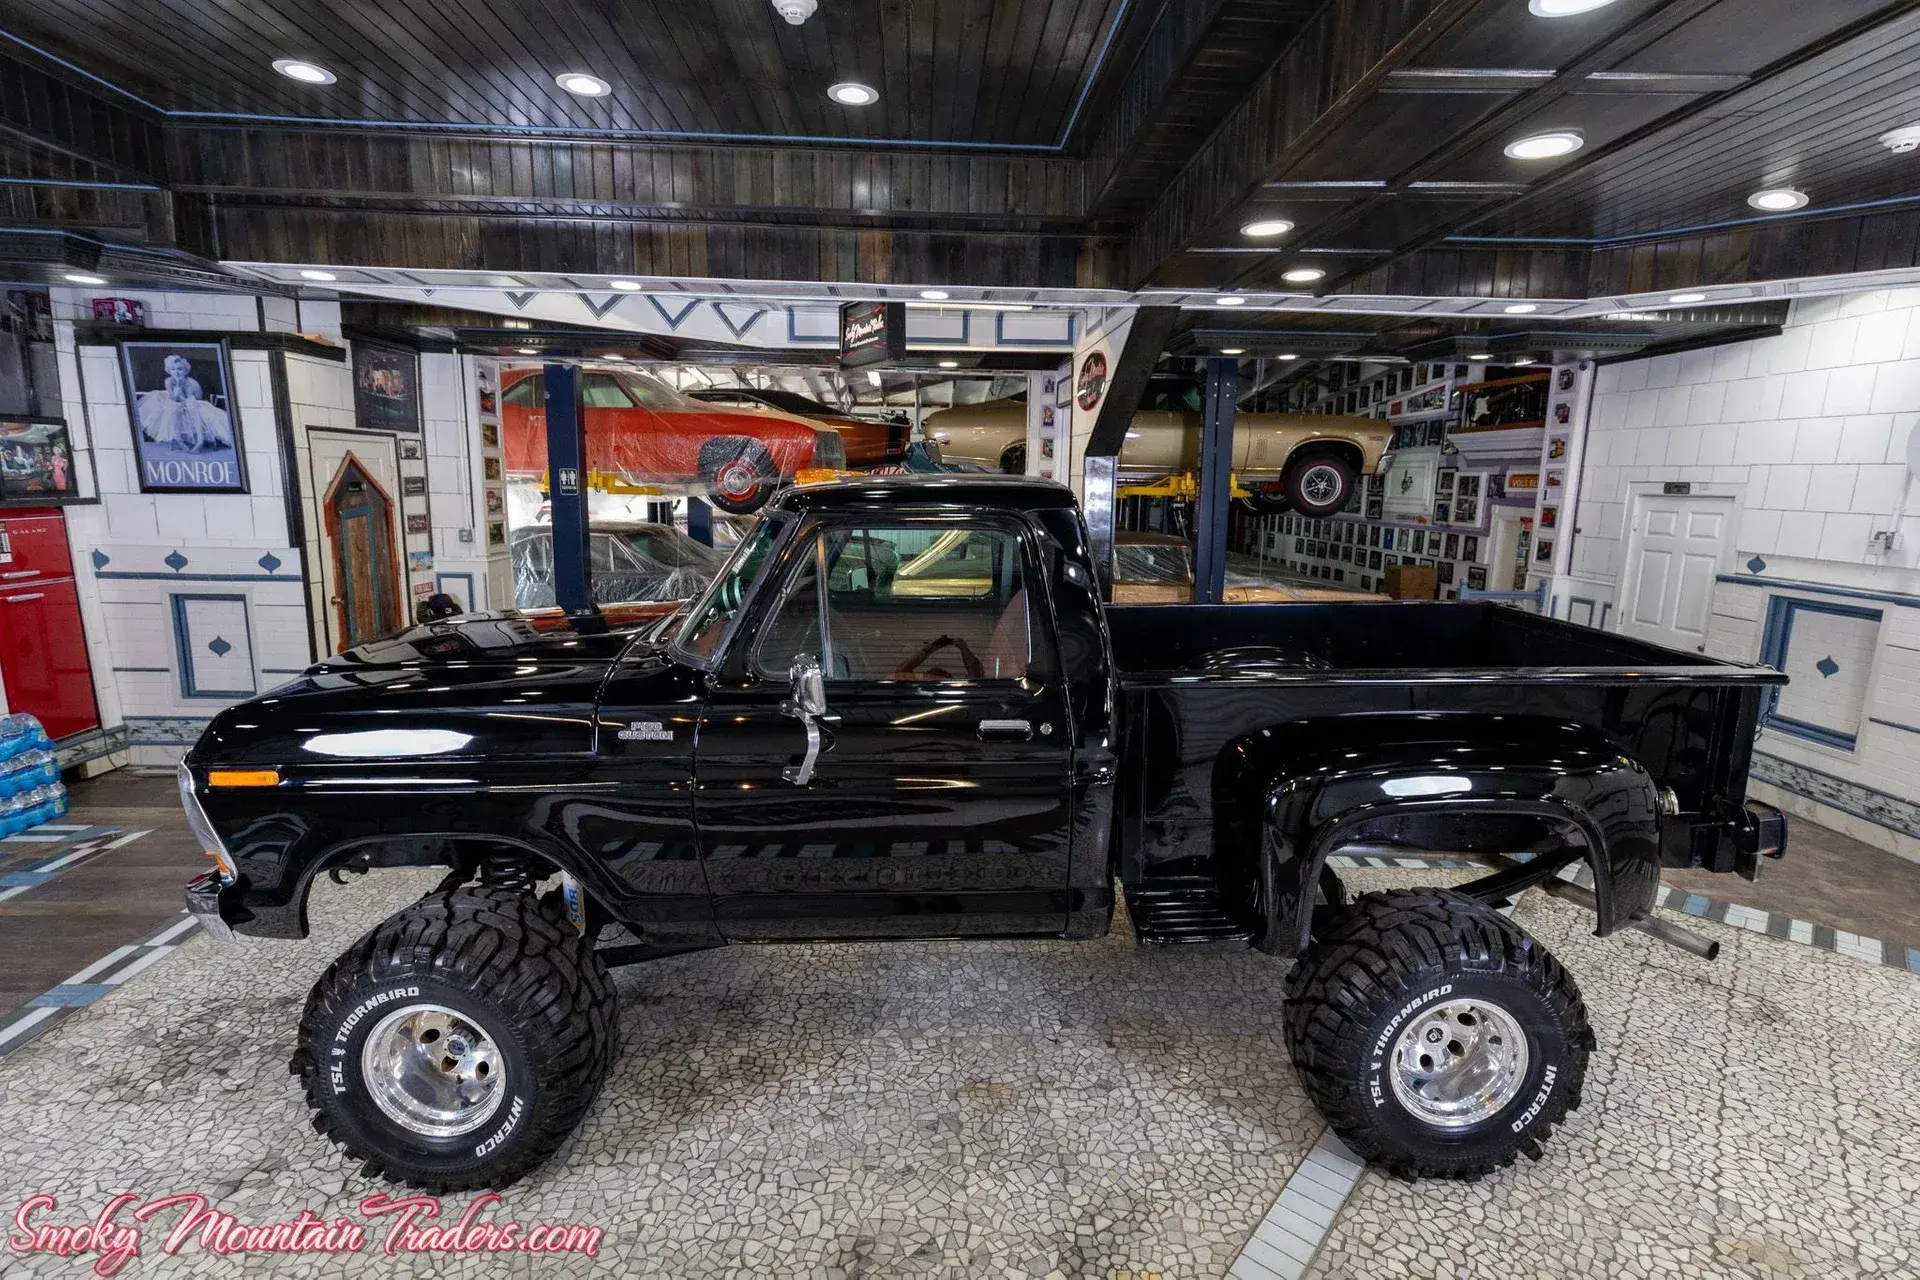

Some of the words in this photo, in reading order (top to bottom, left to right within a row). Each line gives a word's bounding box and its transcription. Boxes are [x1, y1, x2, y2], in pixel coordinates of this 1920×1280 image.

[146, 460, 240, 484] MONROE
[617, 730, 674, 741] CUSTOM
[335, 986, 420, 1042] THORNBIRD
[1373, 984, 1453, 1056] THORNBIRD
[330, 1061, 347, 1095] TSL
[1370, 1075, 1385, 1108] TSL
[1511, 1064, 1558, 1133] INTERCO
[475, 1095, 524, 1158] INTERCO
